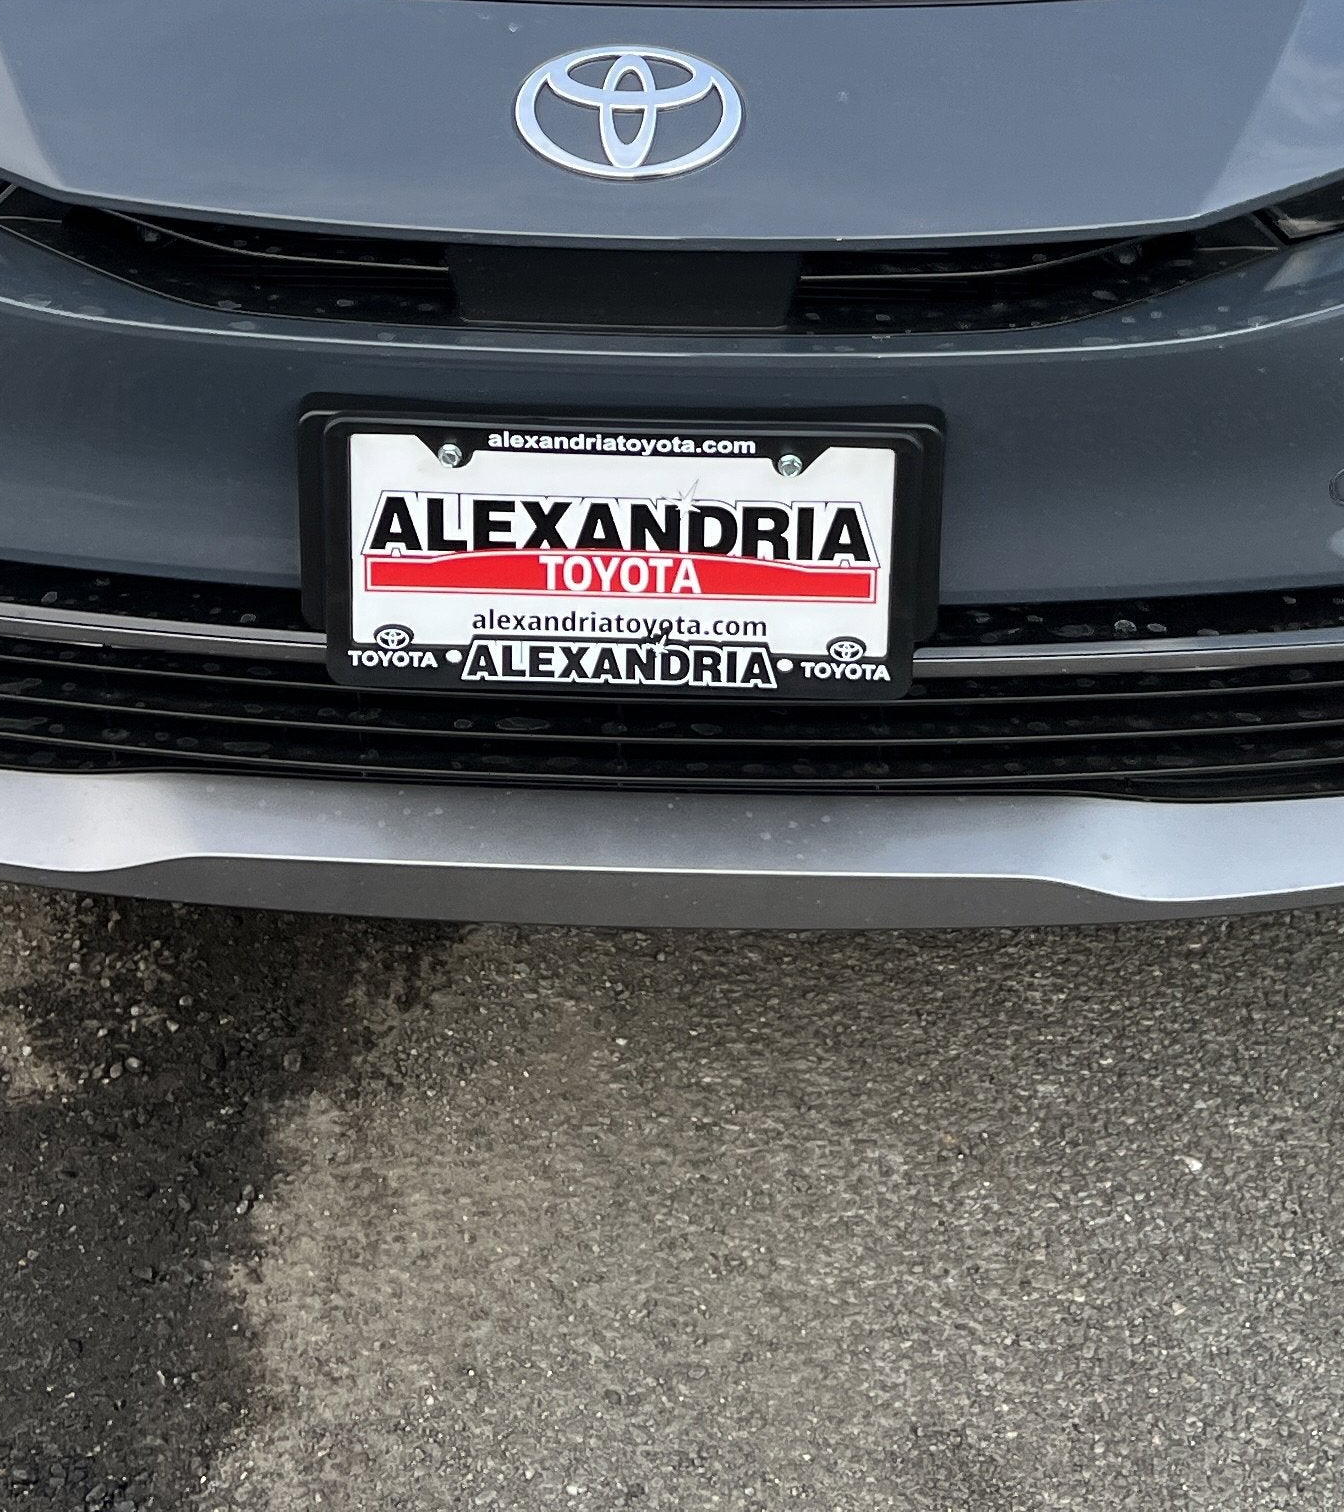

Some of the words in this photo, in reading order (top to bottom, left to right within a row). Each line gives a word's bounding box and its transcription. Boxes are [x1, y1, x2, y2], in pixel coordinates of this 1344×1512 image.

[488, 430, 757, 457] alexandriatoyota.com
[366, 493, 874, 563] ALEXANDRIA
[538, 554, 703, 594] TOYOTA
[472, 608, 768, 638] alexandriatoyota.com
[348, 649, 439, 669] TOYOTA
[461, 639, 777, 688] ALEXANDRIA
[800, 660, 891, 681] TOYOTA
